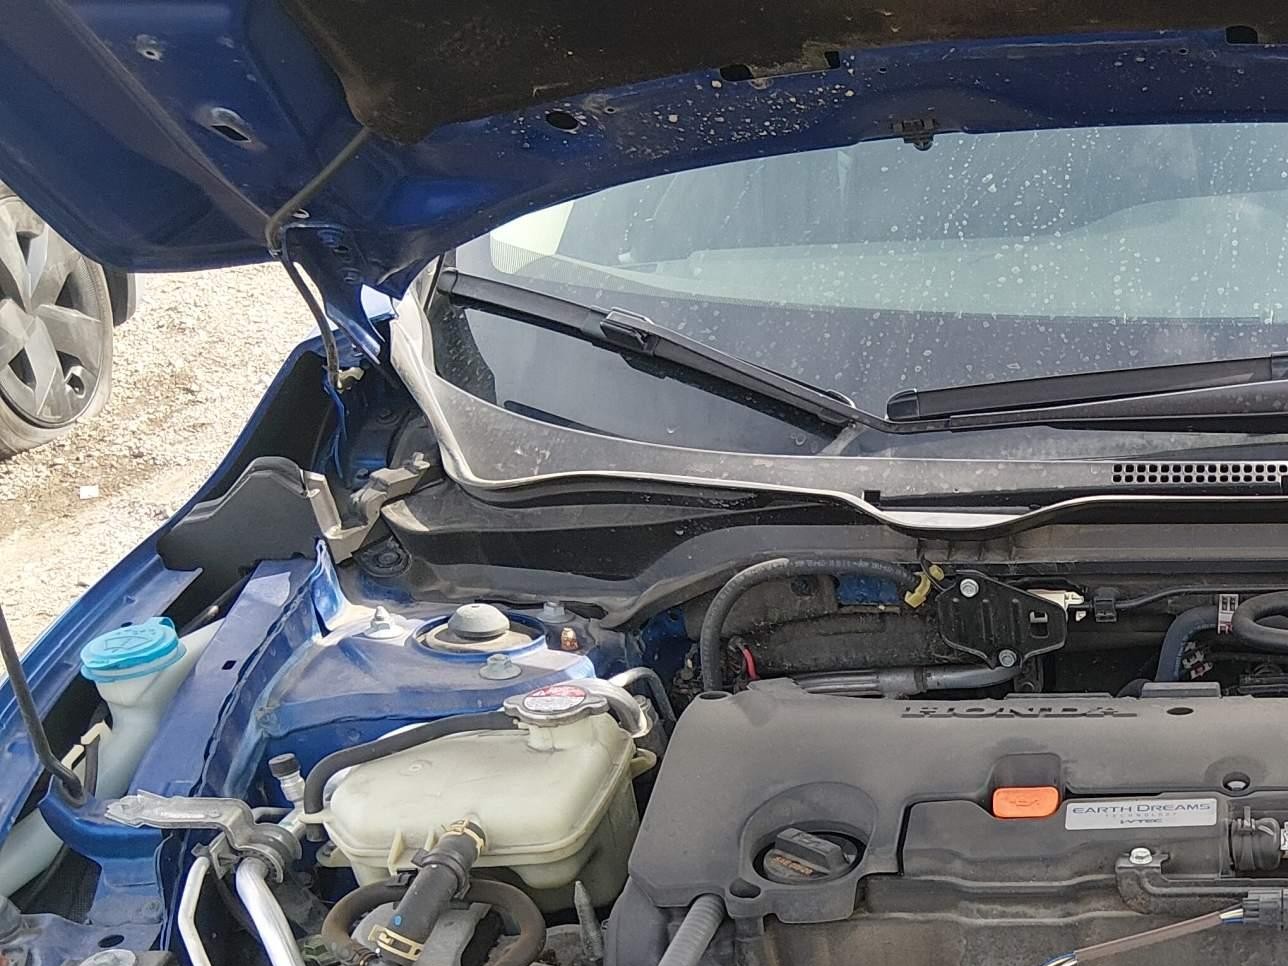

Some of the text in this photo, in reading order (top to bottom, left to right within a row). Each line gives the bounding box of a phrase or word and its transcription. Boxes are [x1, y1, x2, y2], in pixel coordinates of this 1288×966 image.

[901, 706, 1138, 718] HONDA
[1072, 803, 1211, 814] EARTH DREAMS
